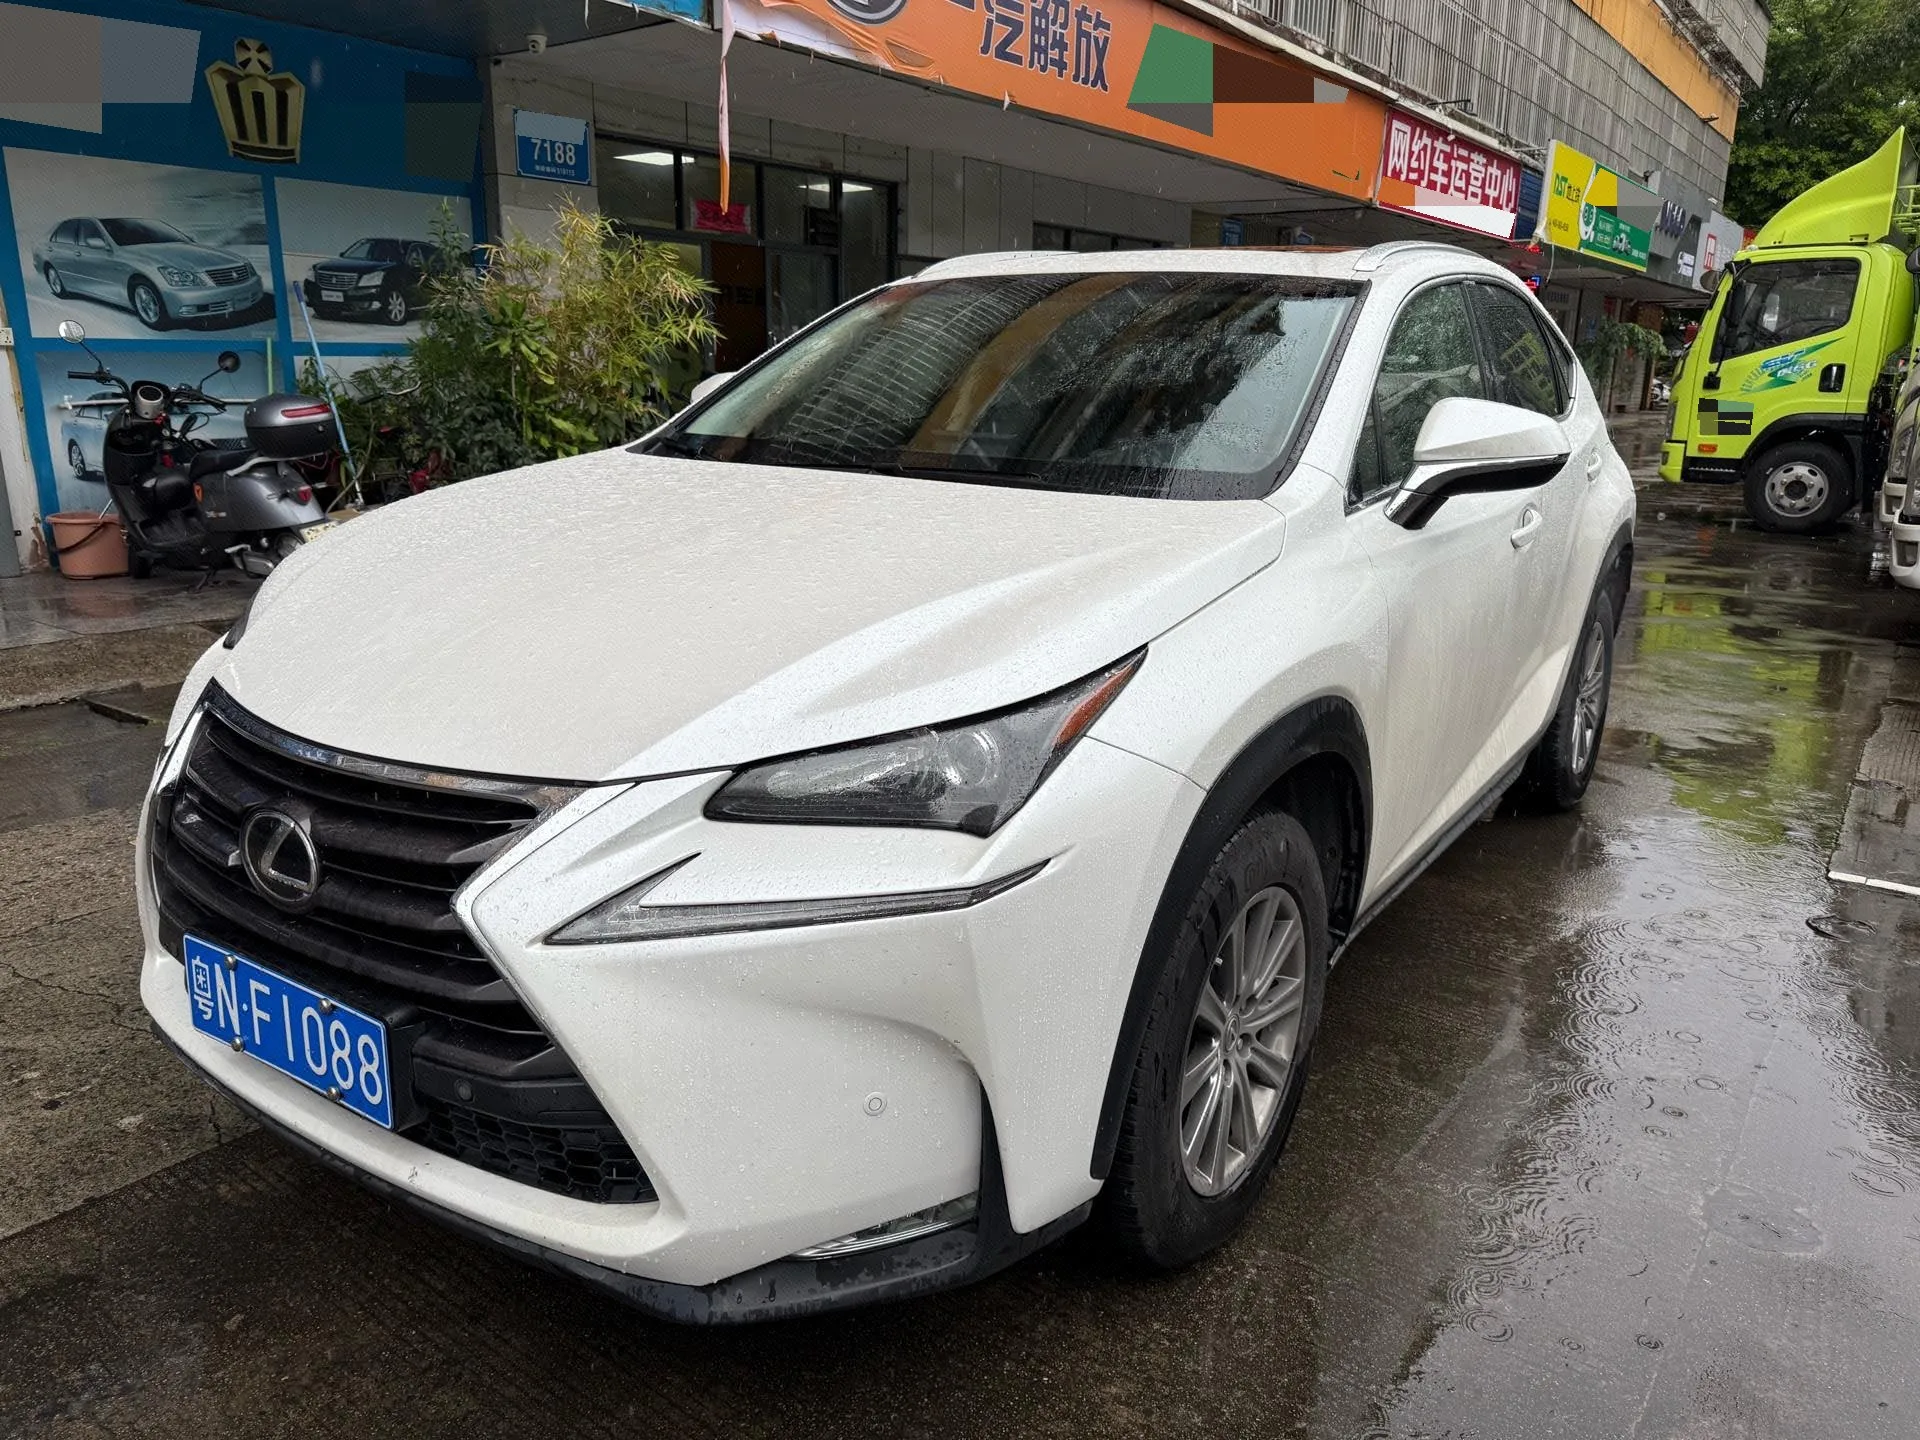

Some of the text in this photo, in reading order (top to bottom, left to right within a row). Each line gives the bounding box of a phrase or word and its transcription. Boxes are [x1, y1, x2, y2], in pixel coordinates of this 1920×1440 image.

[939, 0, 1112, 92] 汽解放
[531, 138, 576, 166] 7188
[1387, 119, 1517, 213] 网约车运营中心
